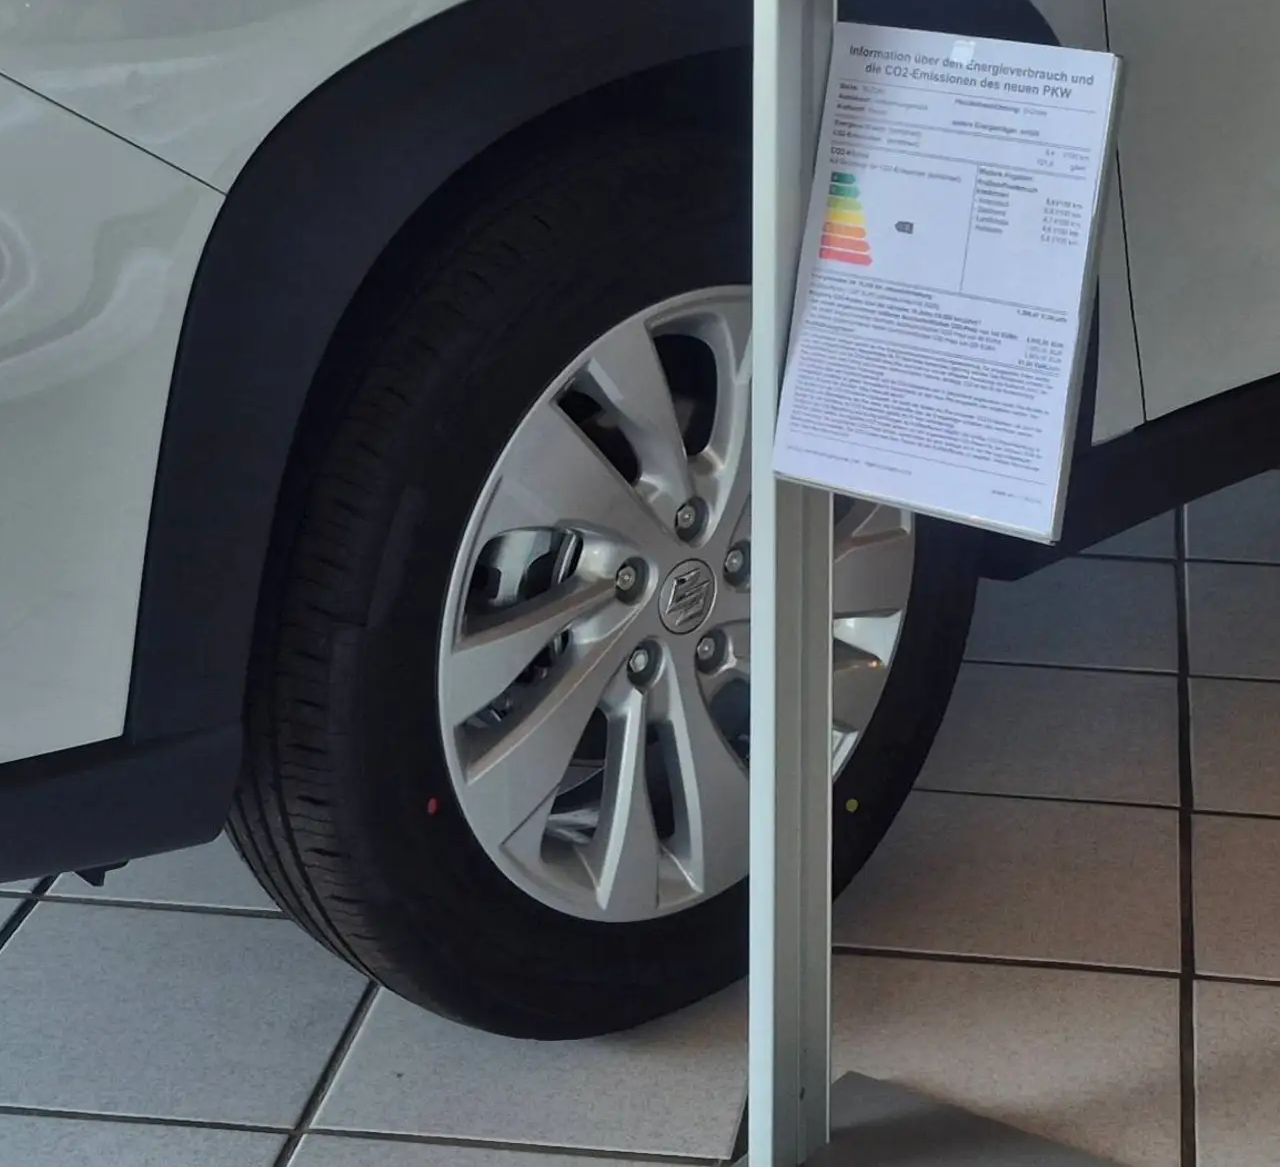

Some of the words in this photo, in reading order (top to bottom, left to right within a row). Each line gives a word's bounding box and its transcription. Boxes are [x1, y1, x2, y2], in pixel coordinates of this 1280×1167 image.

[849, 44, 912, 64] Information
[914, 52, 940, 66] über
[942, 56, 963, 70] den
[965, 58, 1068, 82] Energieverbrauch
[1071, 74, 1094, 86] und
[865, 63, 882, 74] die
[885, 64, 977, 87] CO2-Emissionen
[980, 76, 1000, 90] des
[1003, 82, 1039, 95] neuen
[1043, 84, 1072, 100] PKW
